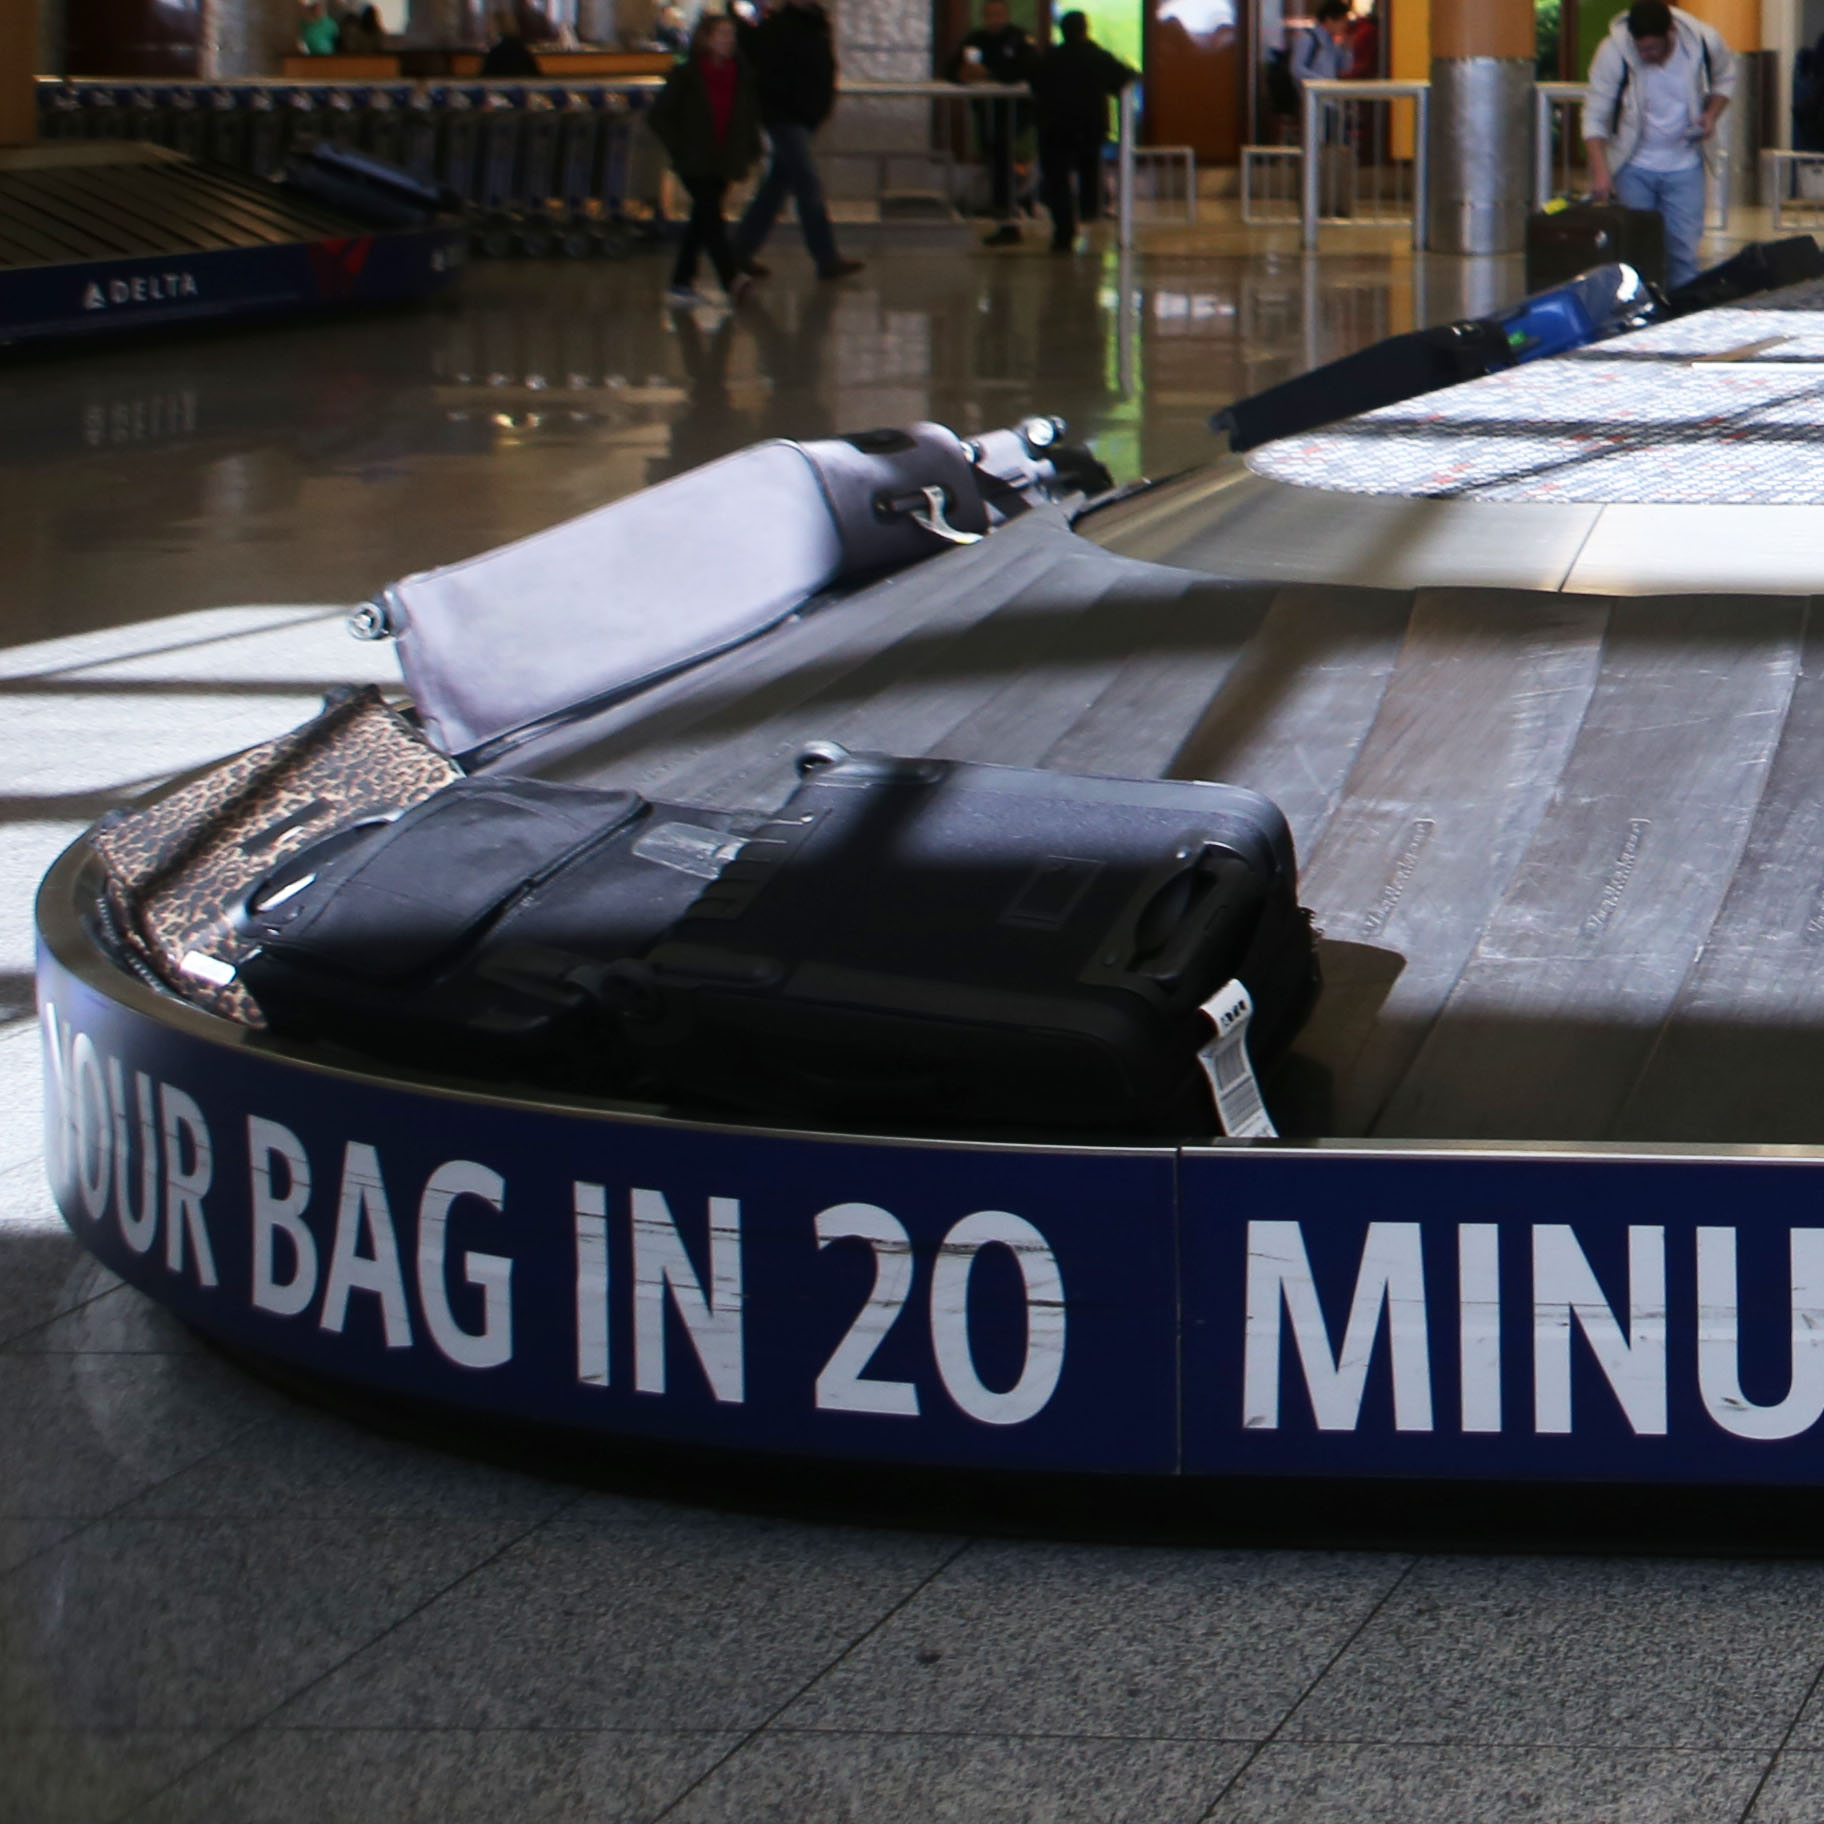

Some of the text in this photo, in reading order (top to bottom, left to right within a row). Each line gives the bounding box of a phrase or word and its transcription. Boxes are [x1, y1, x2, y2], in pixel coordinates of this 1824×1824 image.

[110, 272, 198, 304] DELTA
[46, 1003, 220, 1286] YOUR
[248, 1114, 514, 1370] BAG
[574, 1181, 745, 1404] IN
[814, 1202, 1067, 1425] 20
